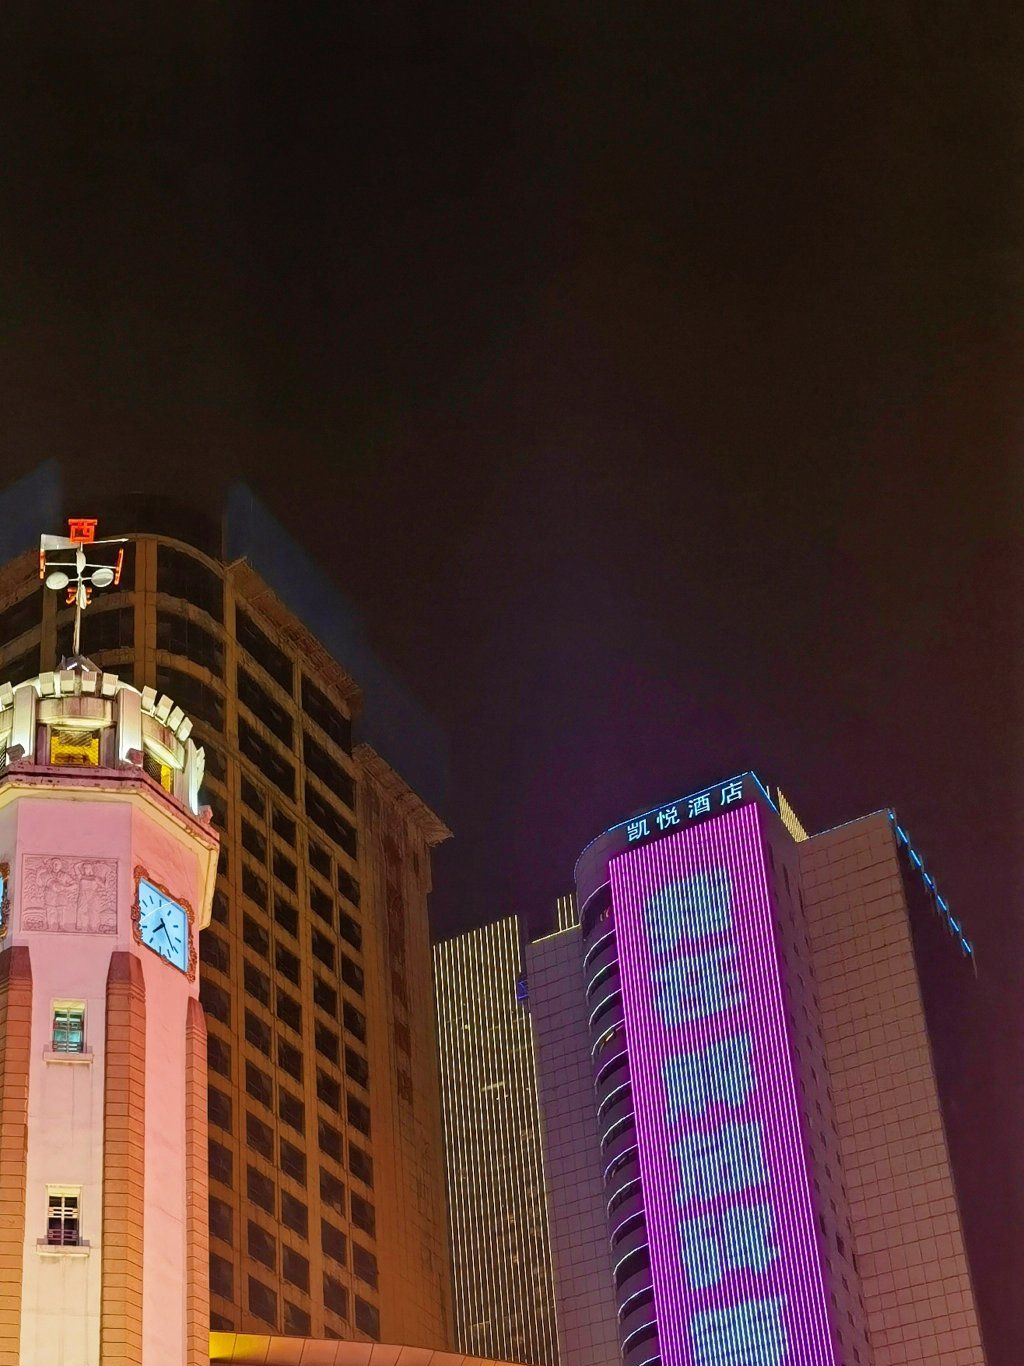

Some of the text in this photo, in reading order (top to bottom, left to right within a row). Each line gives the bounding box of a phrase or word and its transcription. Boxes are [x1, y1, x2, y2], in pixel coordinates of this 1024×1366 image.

[69, 519, 97, 544] 西
[627, 781, 743, 842] 凯悦酒店
